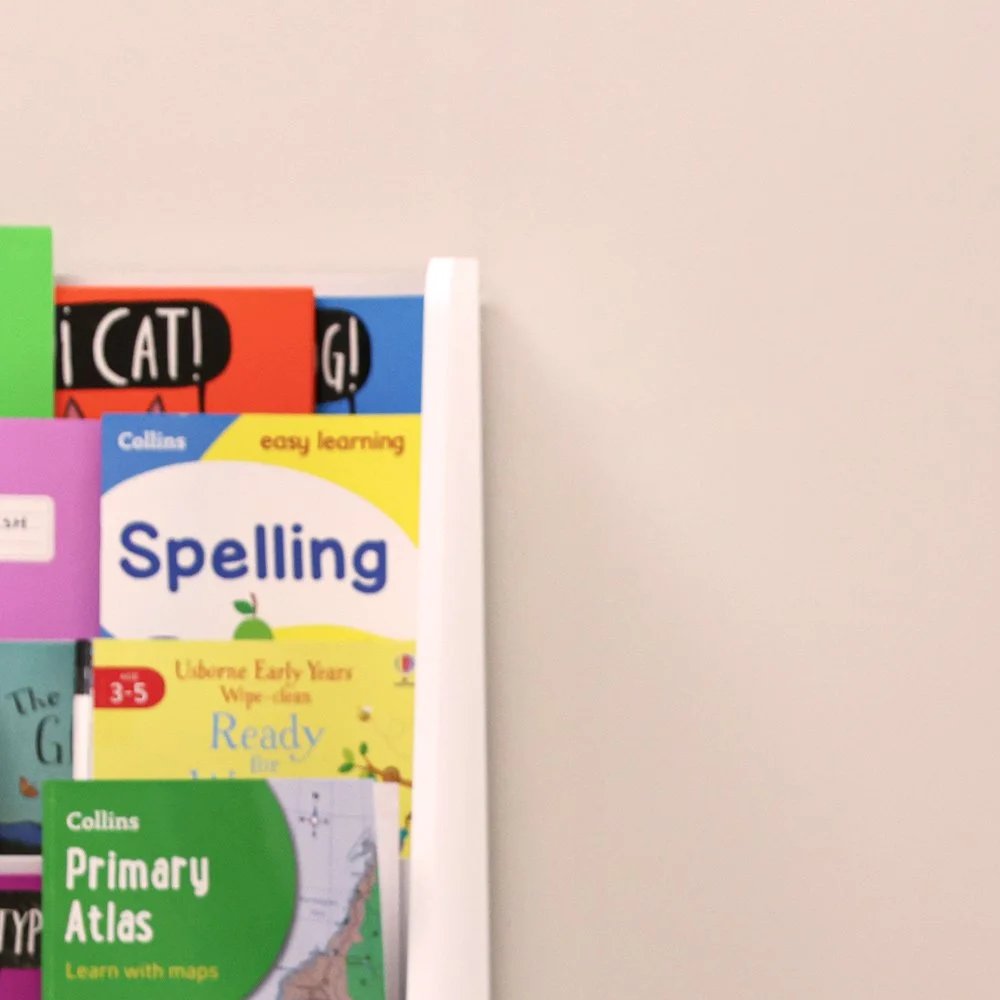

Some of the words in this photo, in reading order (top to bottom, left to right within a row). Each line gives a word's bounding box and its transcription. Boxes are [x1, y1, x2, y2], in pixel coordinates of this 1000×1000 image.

[92, 306, 203, 386] CAT!
[117, 430, 187, 452] Collins
[260, 435, 310, 457] easy
[317, 430, 405, 457] learning
[119, 521, 387, 593] Spelling
[175, 659, 247, 680] Usborne
[254, 658, 303, 687] Early
[307, 660, 353, 681] Years
[10, 686, 61, 715] The
[110, 681, 148, 704] 3-5
[210, 711, 325, 762] Ready
[66, 810, 139, 831] Collins
[66, 846, 210, 897] Primary
[65, 899, 153, 943] Atlas
[66, 962, 119, 980] Learn
[124, 963, 164, 979] with
[169, 966, 219, 984] maps
